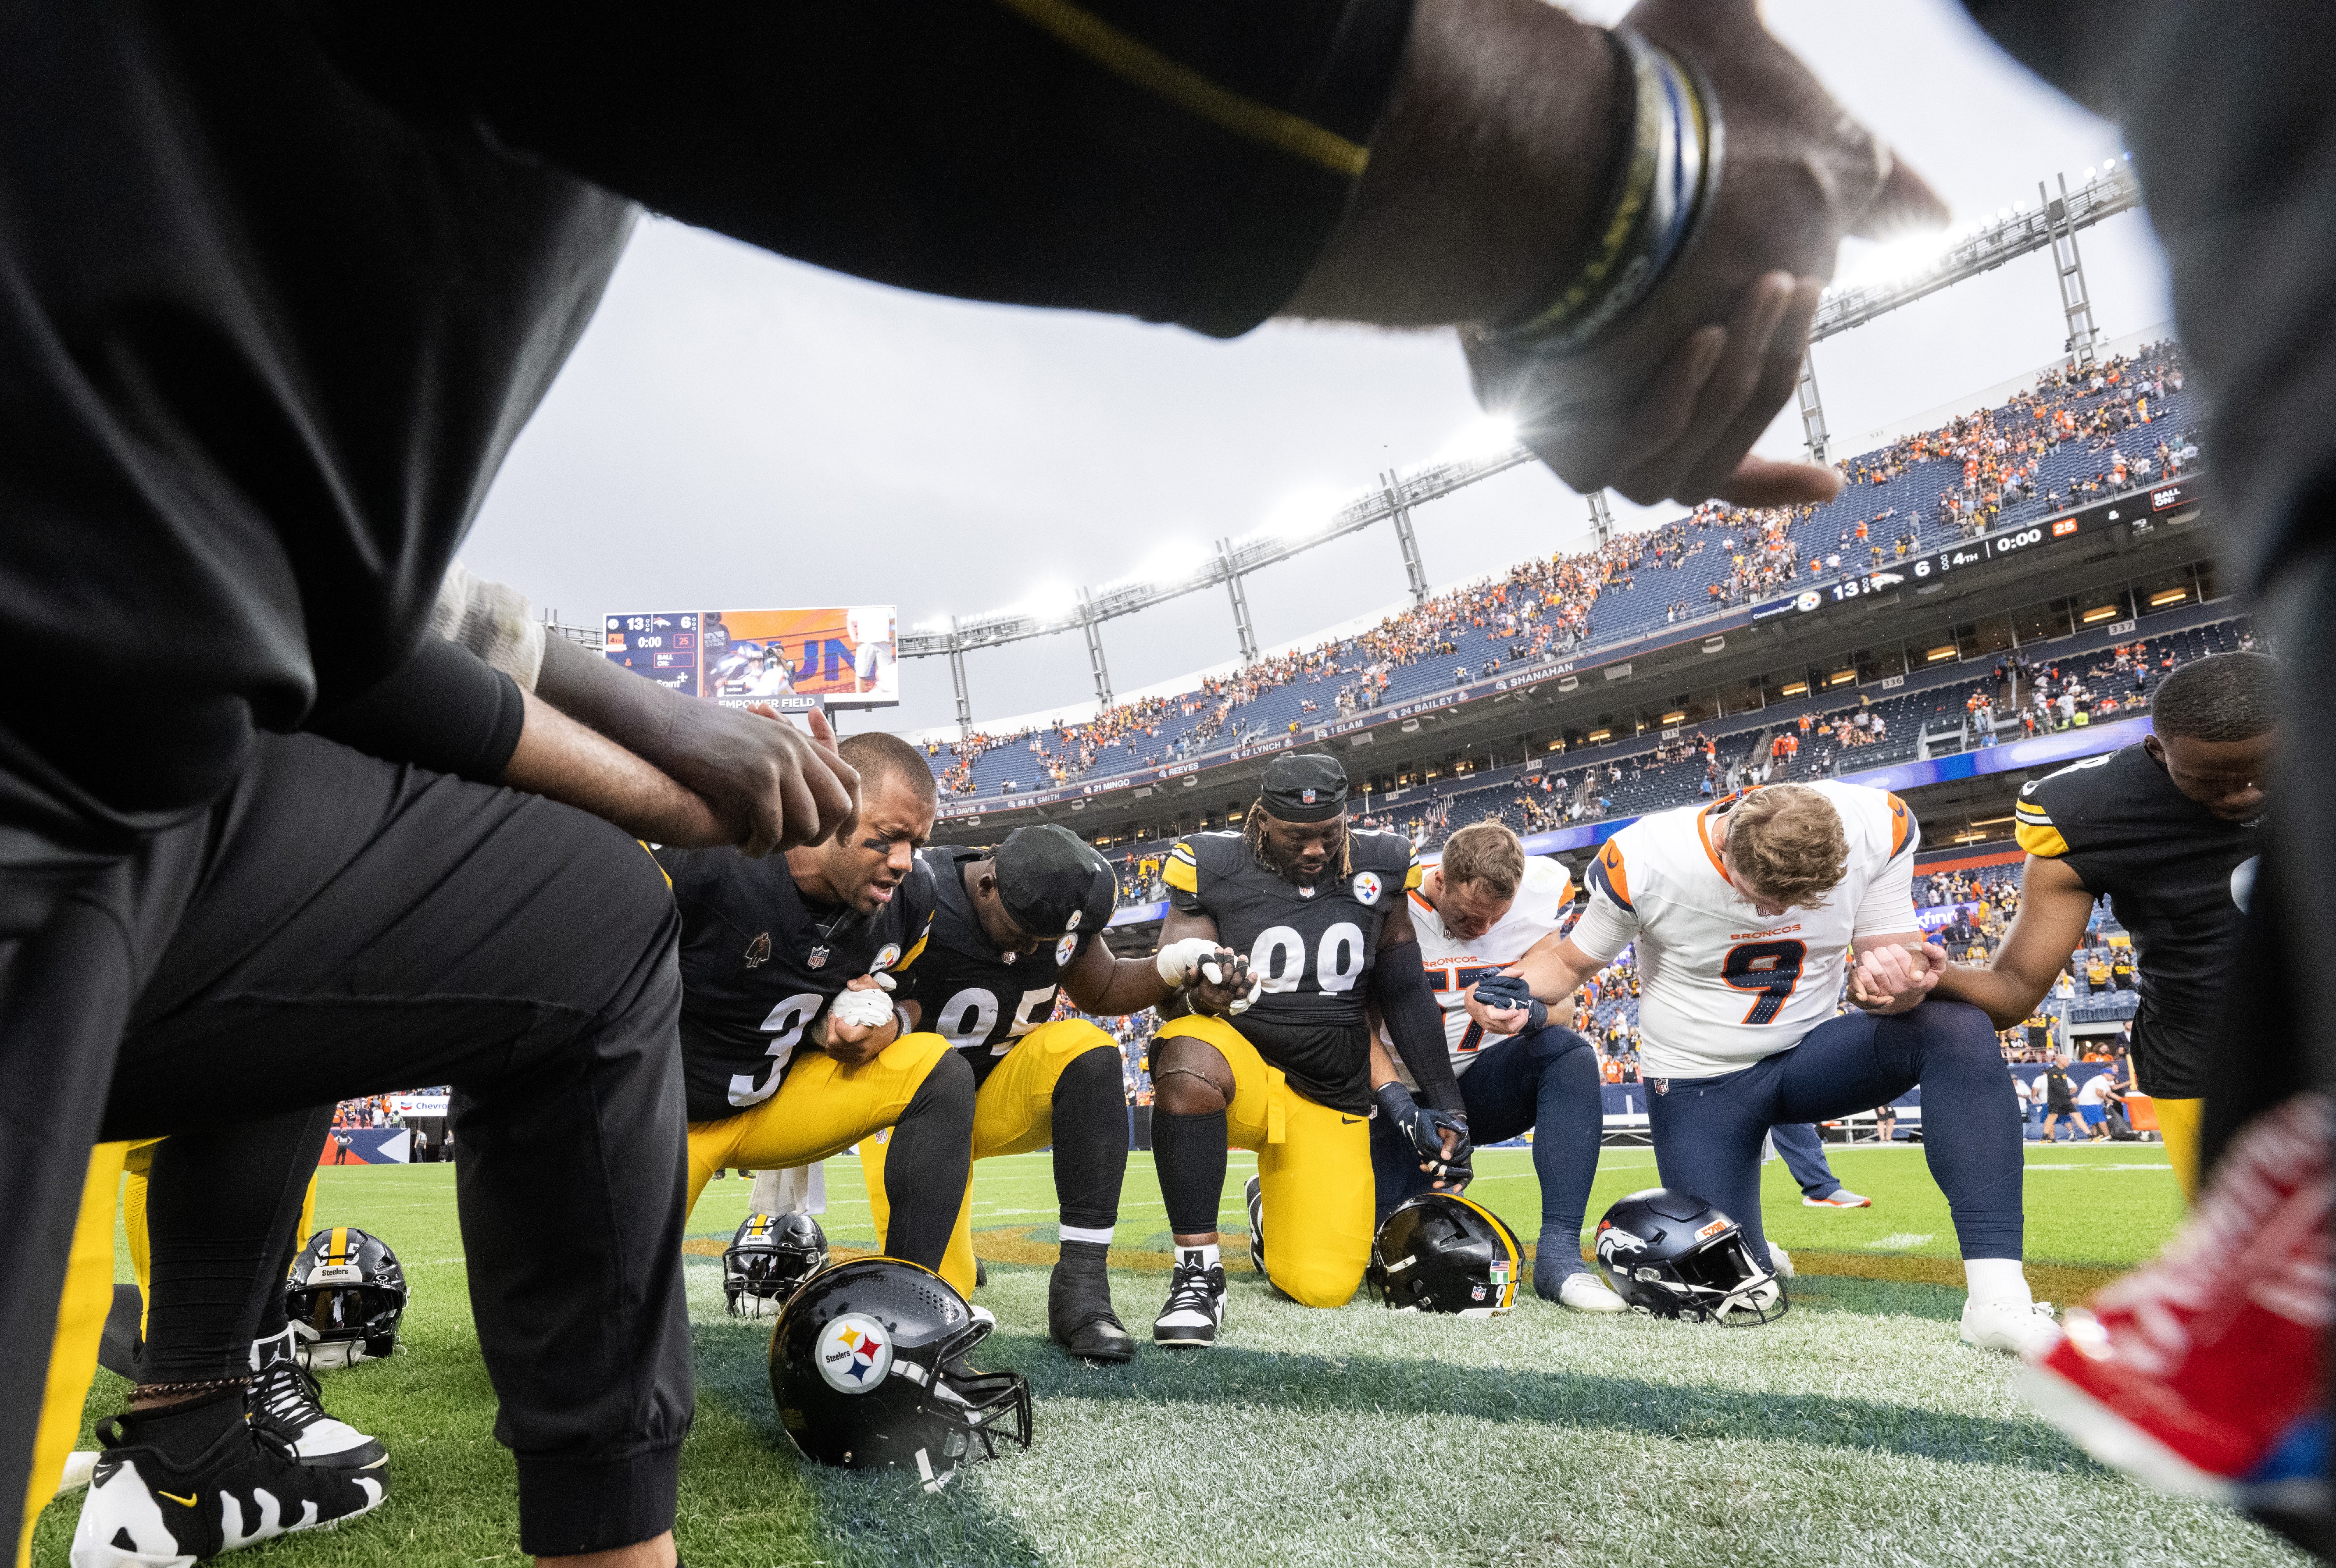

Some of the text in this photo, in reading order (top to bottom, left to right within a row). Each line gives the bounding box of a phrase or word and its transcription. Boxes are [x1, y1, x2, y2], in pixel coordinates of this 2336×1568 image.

[2154, 488, 2181, 500] BALL
[2154, 496, 2175, 506] ON:
[1833, 581, 1859, 600] 13
[1915, 561, 1930, 577] 6
[1952, 552, 1978, 565] 4TH
[1997, 529, 2042, 552] 0:00
[2054, 520, 2075, 534] 25
[627, 617, 644, 630] 13
[681, 616, 691, 628] 6
[2110, 622, 2133, 634] 337
[638, 636, 661, 648] 0:00
[1510, 663, 1573, 687] SHANAHAN
[1884, 677, 1903, 687] 336
[782, 698, 815, 707] FIELD
[1401, 696, 1453, 716] 24 BAILEY
[1337, 720, 1363, 734] ELAM
[1241, 741, 1281, 757] 47 LYNCH
[1169, 762, 1199, 776] REEVES
[1103, 778, 1130, 790] MINGO
[1038, 793, 1060, 804] SMITH
[957, 806, 976, 815] DAVIS
[1730, 924, 1802, 940] BRONCOS
[811, 956, 823, 965] NFL
[1004, 952, 1015, 961] NFL
[1422, 956, 1478, 967] BRONCOS
[1720, 938, 1807, 1025] 9
[936, 983, 1057, 1056] 95
[728, 993, 823, 1106] 3
[1606, 1065, 1618, 1074] 33
[877, 1133, 886, 1141] NFL
[321, 1268, 349, 1276] Steelers
[825, 1351, 851, 1363] Steelers
